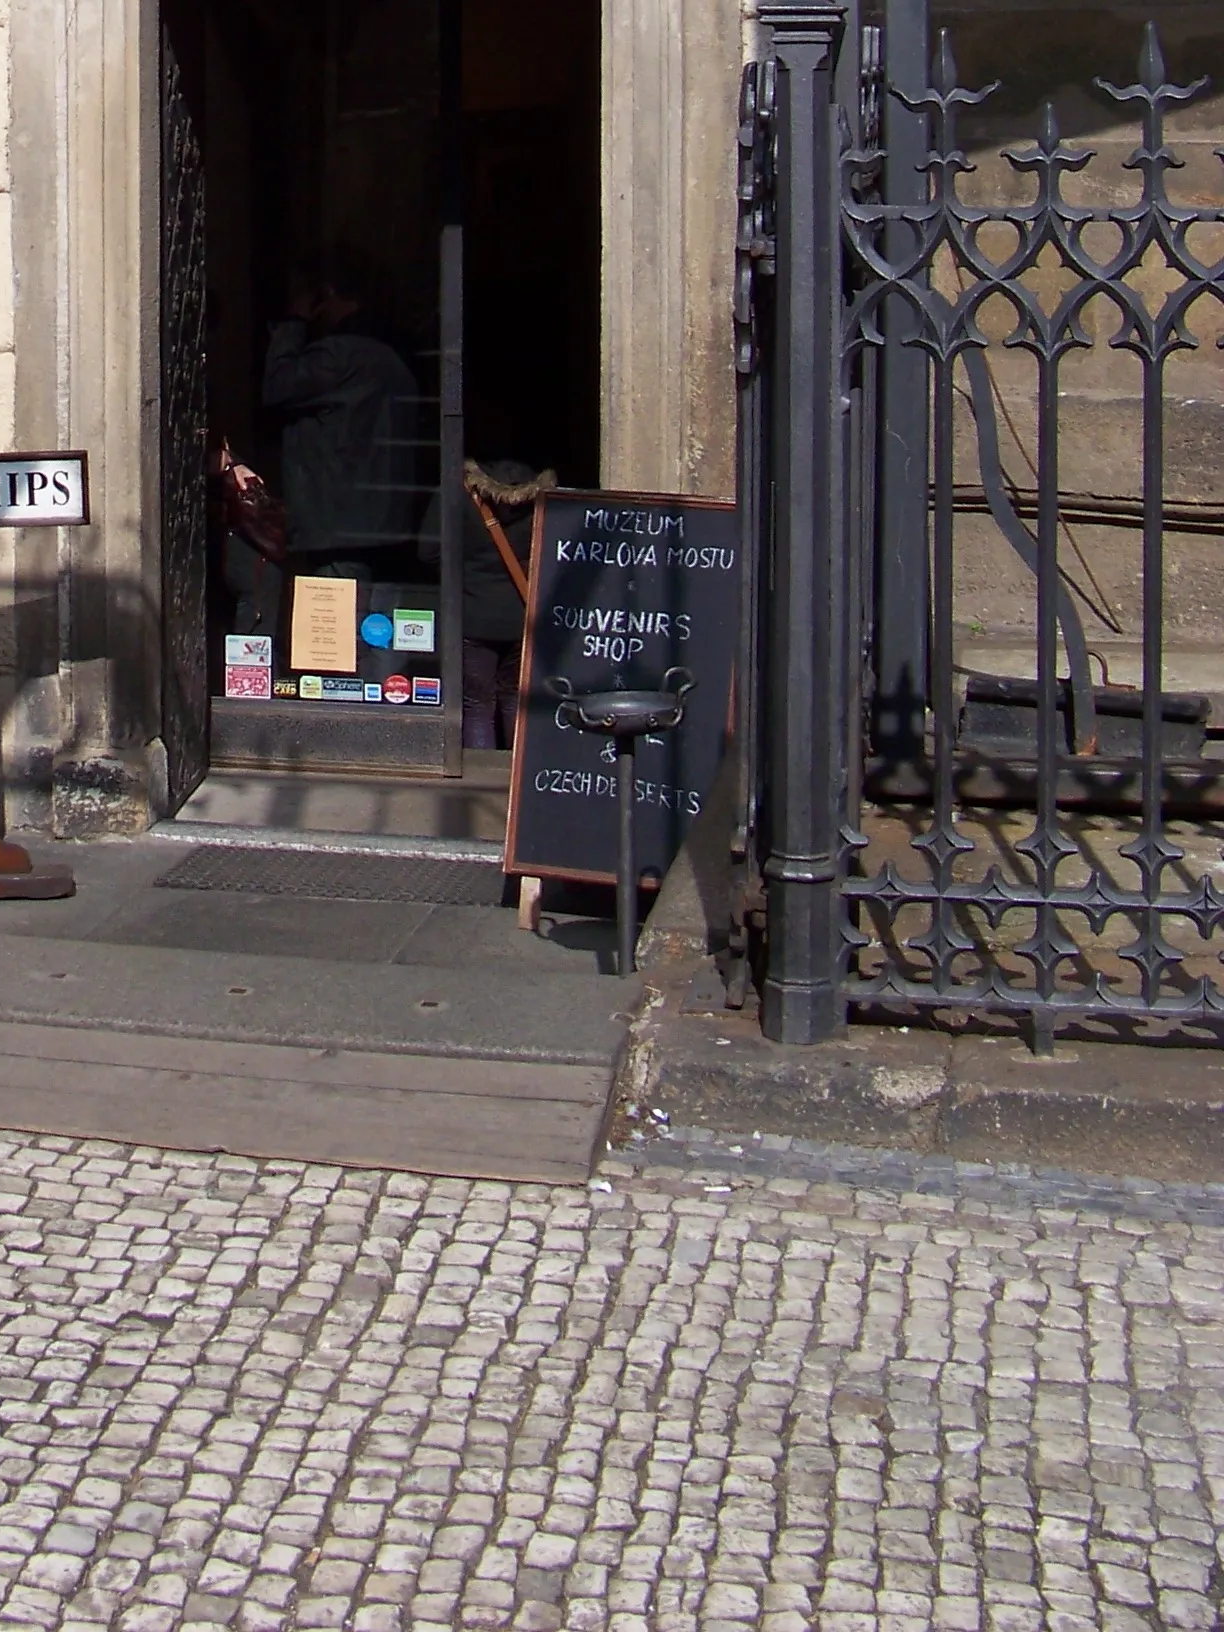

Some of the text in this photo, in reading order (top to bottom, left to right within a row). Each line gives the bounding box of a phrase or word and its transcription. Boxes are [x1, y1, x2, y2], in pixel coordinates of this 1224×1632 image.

[584, 509, 684, 537] MUZEUM
[555, 540, 735, 570] KARLOVA MOSTU
[552, 605, 691, 641] SOUVENIRS
[582, 635, 644, 663] SHOP
[534, 769, 702, 816] CZECH DESERTS
